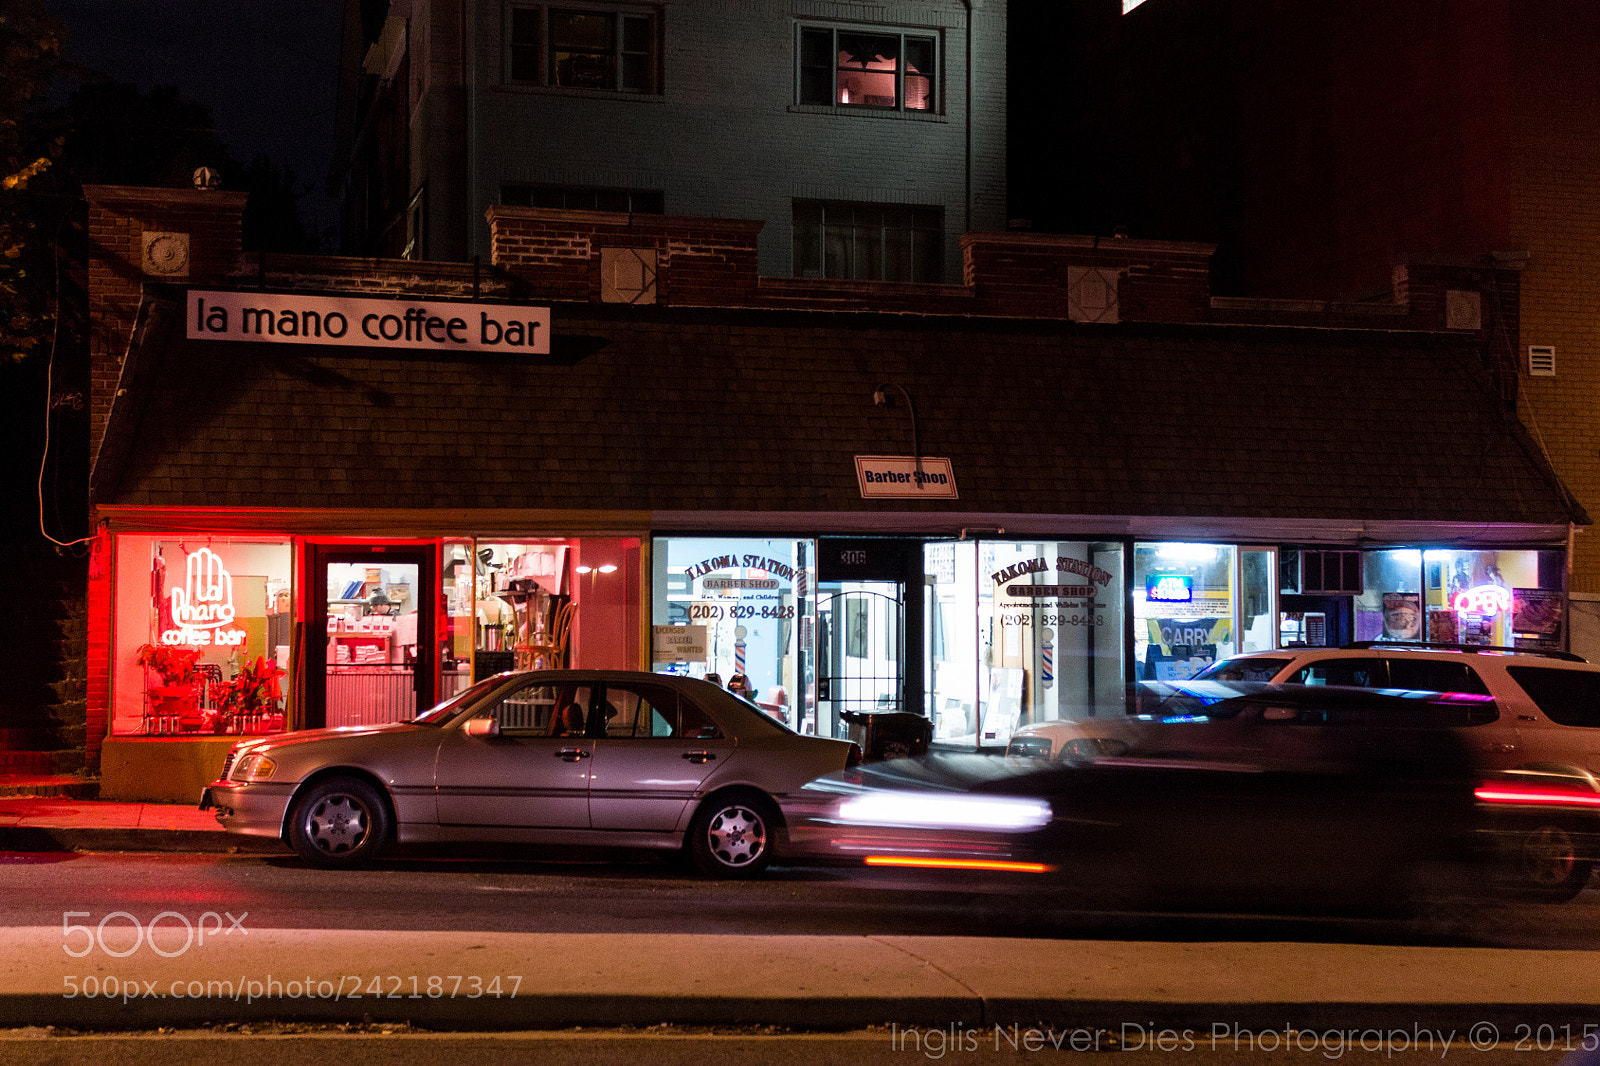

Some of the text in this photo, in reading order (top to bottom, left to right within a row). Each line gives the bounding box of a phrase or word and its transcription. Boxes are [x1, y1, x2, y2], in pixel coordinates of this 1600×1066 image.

[198, 298, 540, 346] la mano coffee bar
[865, 471, 948, 484] Barber Shop
[685, 554, 798, 581] TAKOMA STATION
[991, 557, 1113, 587] TAKOMA STATION
[1010, 587, 1094, 596] BARBER SHOP
[1456, 592, 1508, 612] OPEN
[688, 605, 794, 621] (202) 829-8428
[1000, 614, 1104, 628] (202) 829-8428
[162, 627, 246, 645] coffee bar
[655, 626, 685, 634] LICENSED
